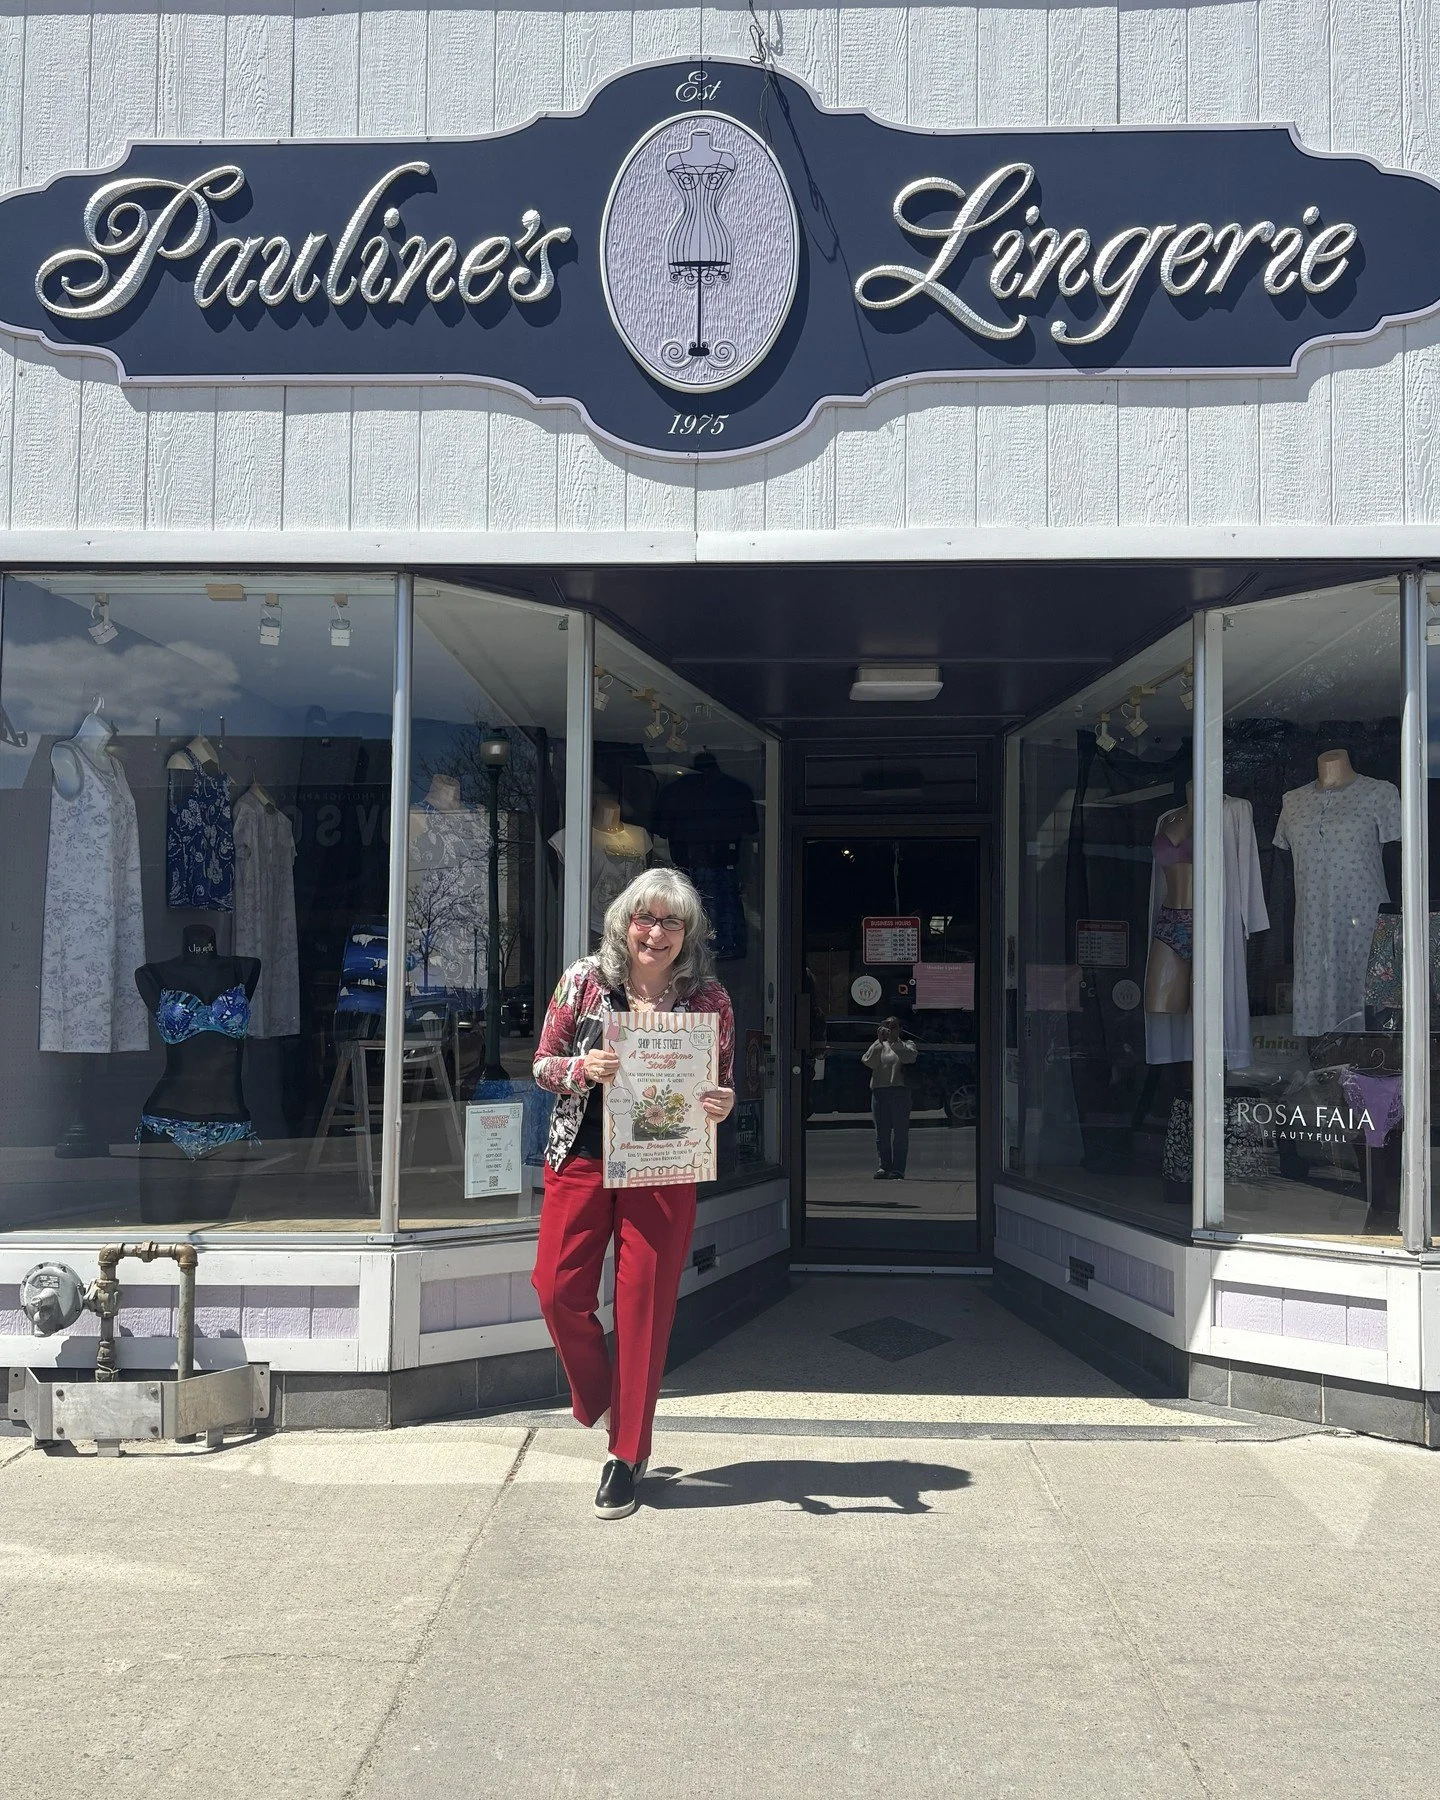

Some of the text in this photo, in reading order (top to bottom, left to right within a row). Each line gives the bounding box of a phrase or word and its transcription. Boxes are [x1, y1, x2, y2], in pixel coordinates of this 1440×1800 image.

[675, 70, 722, 102] Est
[35, 161, 1359, 345] Pauline's Lingerie
[667, 413, 730, 435] 1975
[637, 1038, 651, 1049] SHOP
[652, 1038, 663, 1050] THE
[663, 1038, 683, 1050] STREET
[1252, 1035, 1300, 1050] Anita
[628, 1050, 694, 1063] A Springtime
[646, 1060, 677, 1070] Stroll
[1237, 1102, 1375, 1131] ROSA FAIA
[1263, 1130, 1347, 1143] BEAUTYFULL
